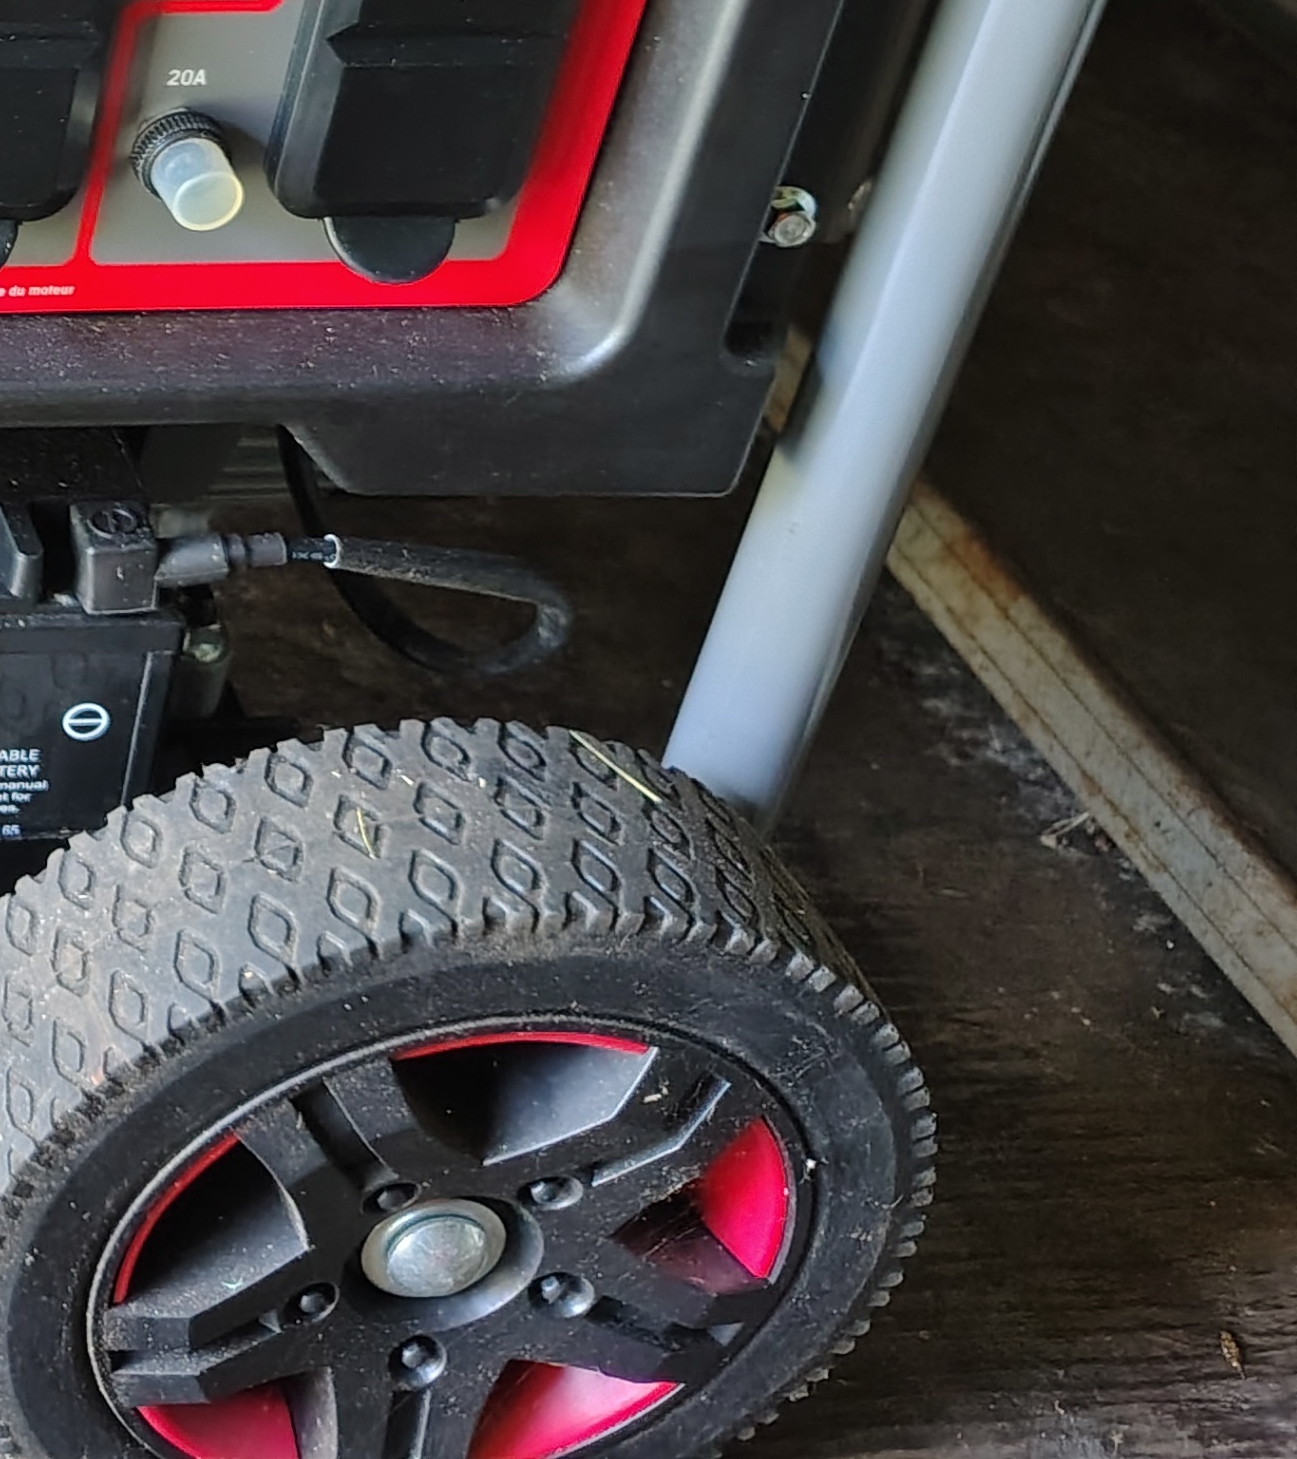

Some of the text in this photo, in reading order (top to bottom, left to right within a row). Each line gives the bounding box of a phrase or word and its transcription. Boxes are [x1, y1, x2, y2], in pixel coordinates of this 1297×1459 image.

[166, 68, 208, 87] 20A
[8, 286, 25, 298] du
[28, 285, 76, 297] moteur
[11, 790, 32, 803] for
[2, 824, 20, 836] 65
